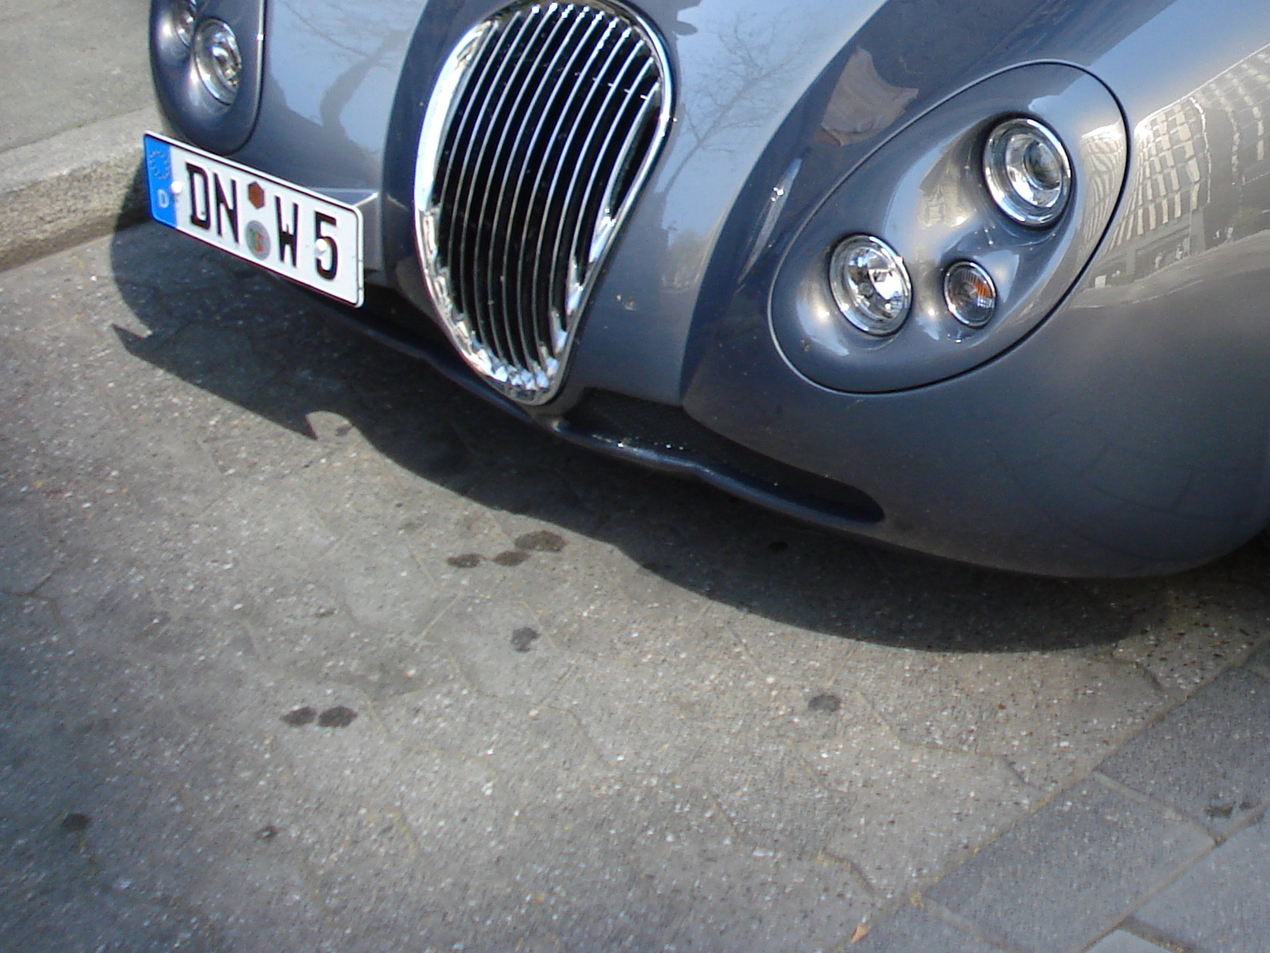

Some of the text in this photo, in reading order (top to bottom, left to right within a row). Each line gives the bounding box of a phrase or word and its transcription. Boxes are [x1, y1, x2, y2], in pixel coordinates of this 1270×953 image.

[157, 188, 170, 209] D
[185, 161, 339, 281] DN W 5
